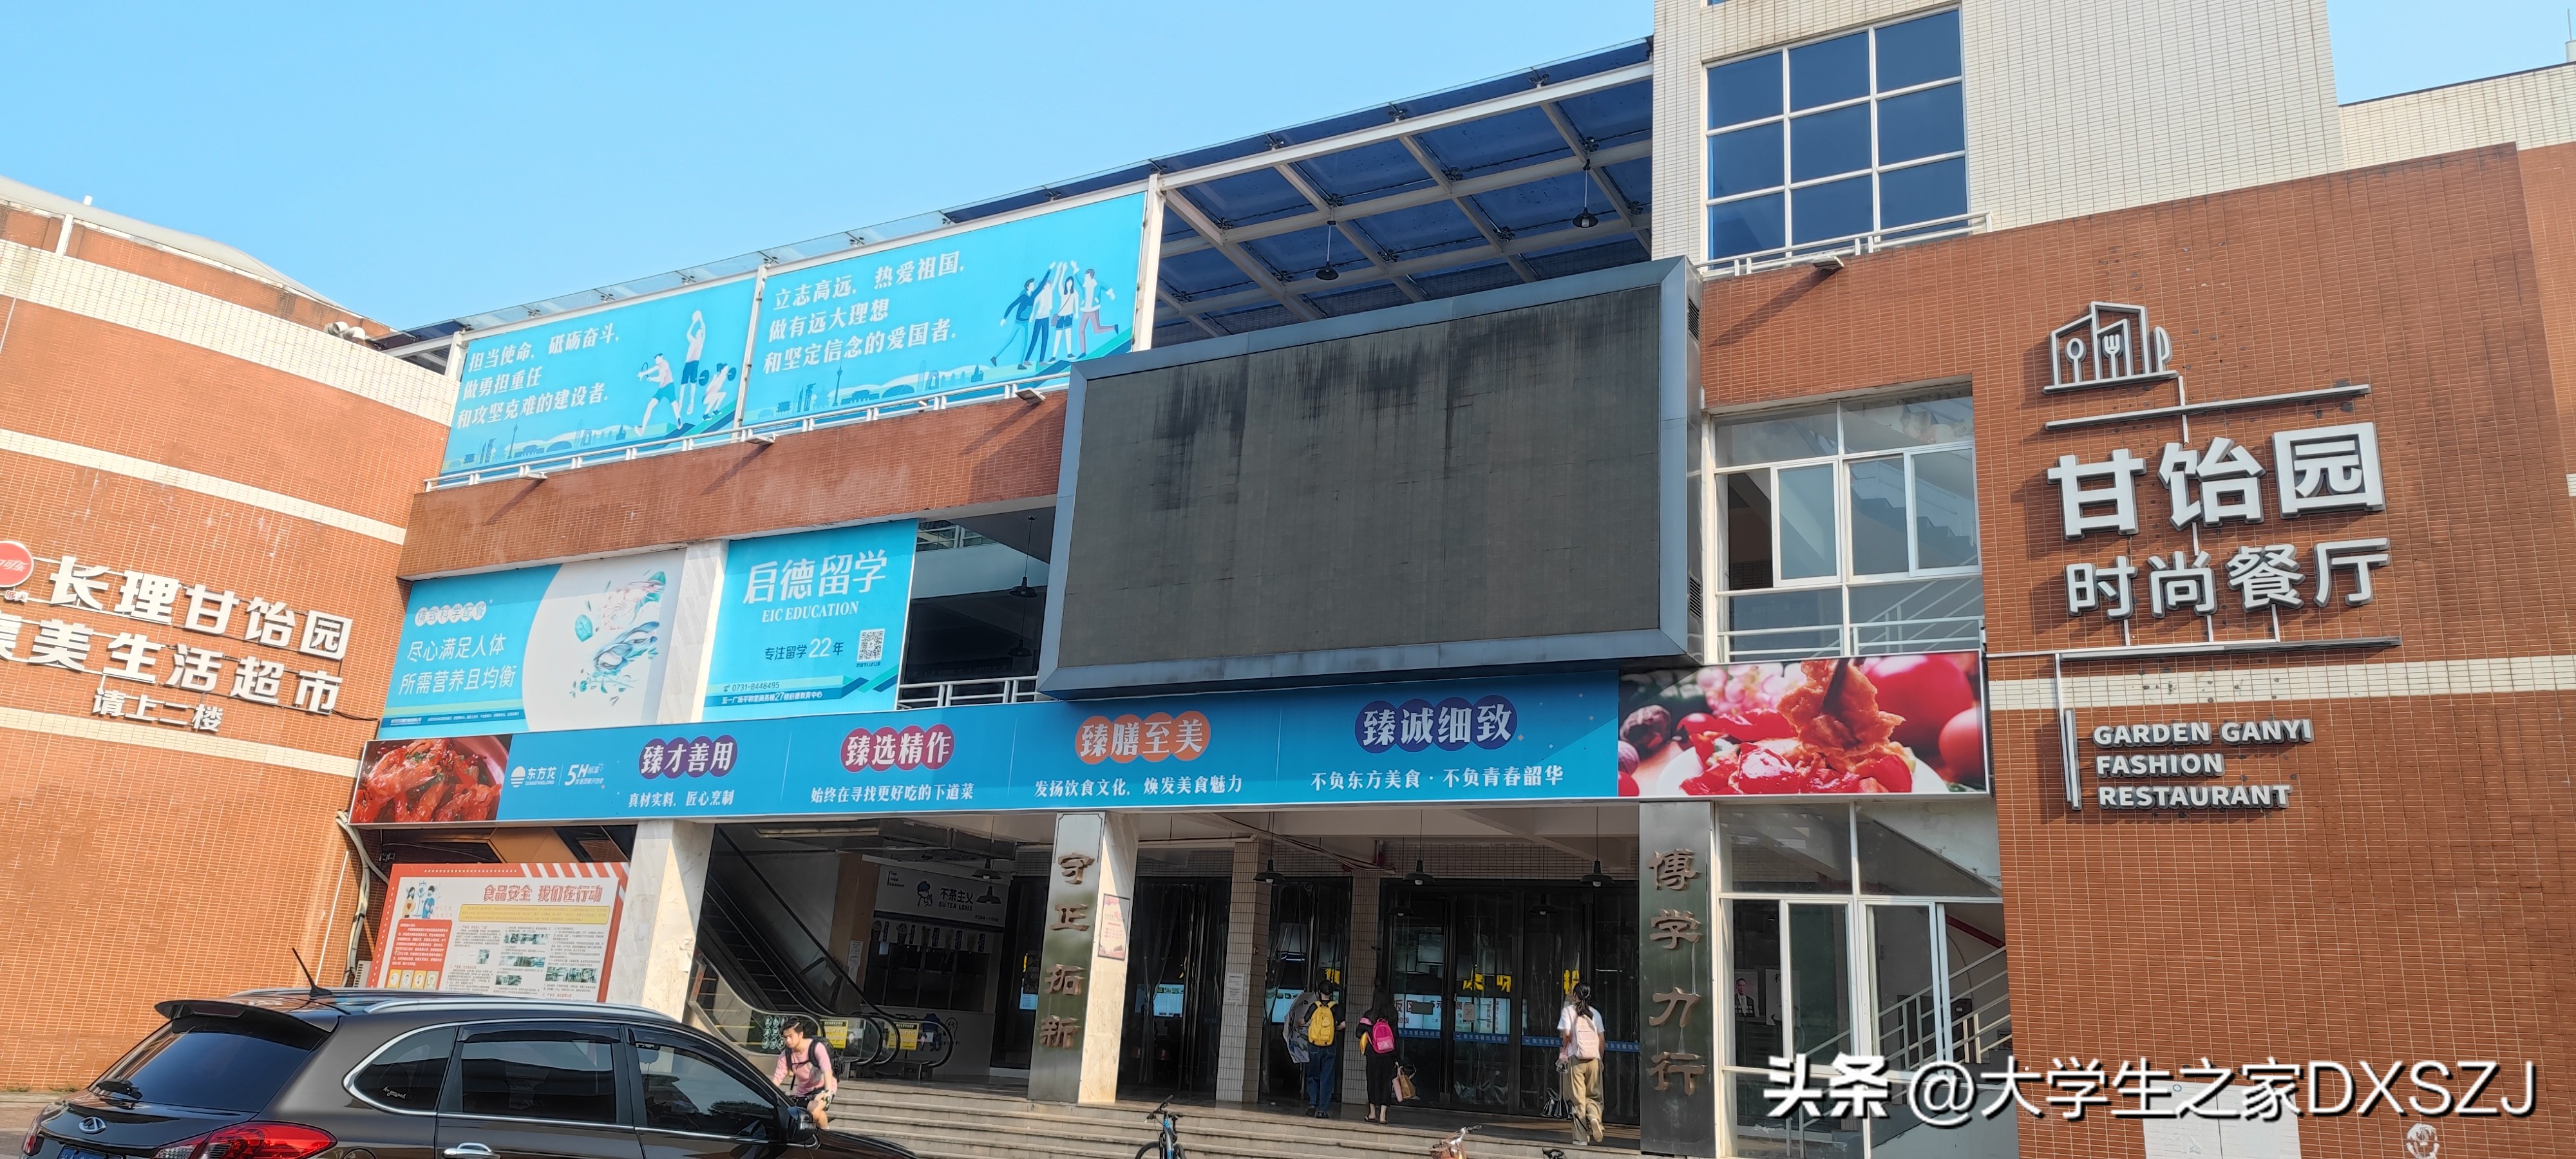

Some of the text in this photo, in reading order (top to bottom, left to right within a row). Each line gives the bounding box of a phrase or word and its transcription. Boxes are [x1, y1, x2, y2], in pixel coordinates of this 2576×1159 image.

[769, 299, 889, 343] 做有远大理想
[764, 319, 956, 375] 和坚定信念的爱国者。
[463, 367, 542, 402] 做勇担重任
[2047, 422, 2385, 541] 甘饴园
[743, 549, 887, 604] 启德留学
[2065, 538, 2391, 617] 时尚餐厅
[48, 556, 353, 661] 长理甘饴园
[762, 601, 860, 623] EIC EDUCATION
[407, 633, 507, 664] 尽心满足人体
[399, 665, 518, 695] 所需营养且均衡
[732, 681, 781, 692] 0731-8448495
[91, 687, 224, 733] 请上二楼
[1362, 702, 1513, 746] 臻诚细致
[846, 730, 953, 767] 臻选精作
[1080, 719, 1204, 757] 臻膳至美
[2093, 718, 2315, 747] GARDEN GANYI
[527, 766, 558, 780] 东方龙
[641, 741, 735, 774] 臻才善用
[2096, 753, 2226, 778] FASHION
[811, 782, 976, 804] 始终在寻找更好吃的下道菜
[2098, 784, 2293, 809] RESTAURANT
[483, 884, 603, 903] 食品安全 我们在行动
[940, 887, 974, 905] 不茶主义
[1039, 852, 1095, 1050] 守正拓新
[1646, 848, 1707, 1096] 博学力行
